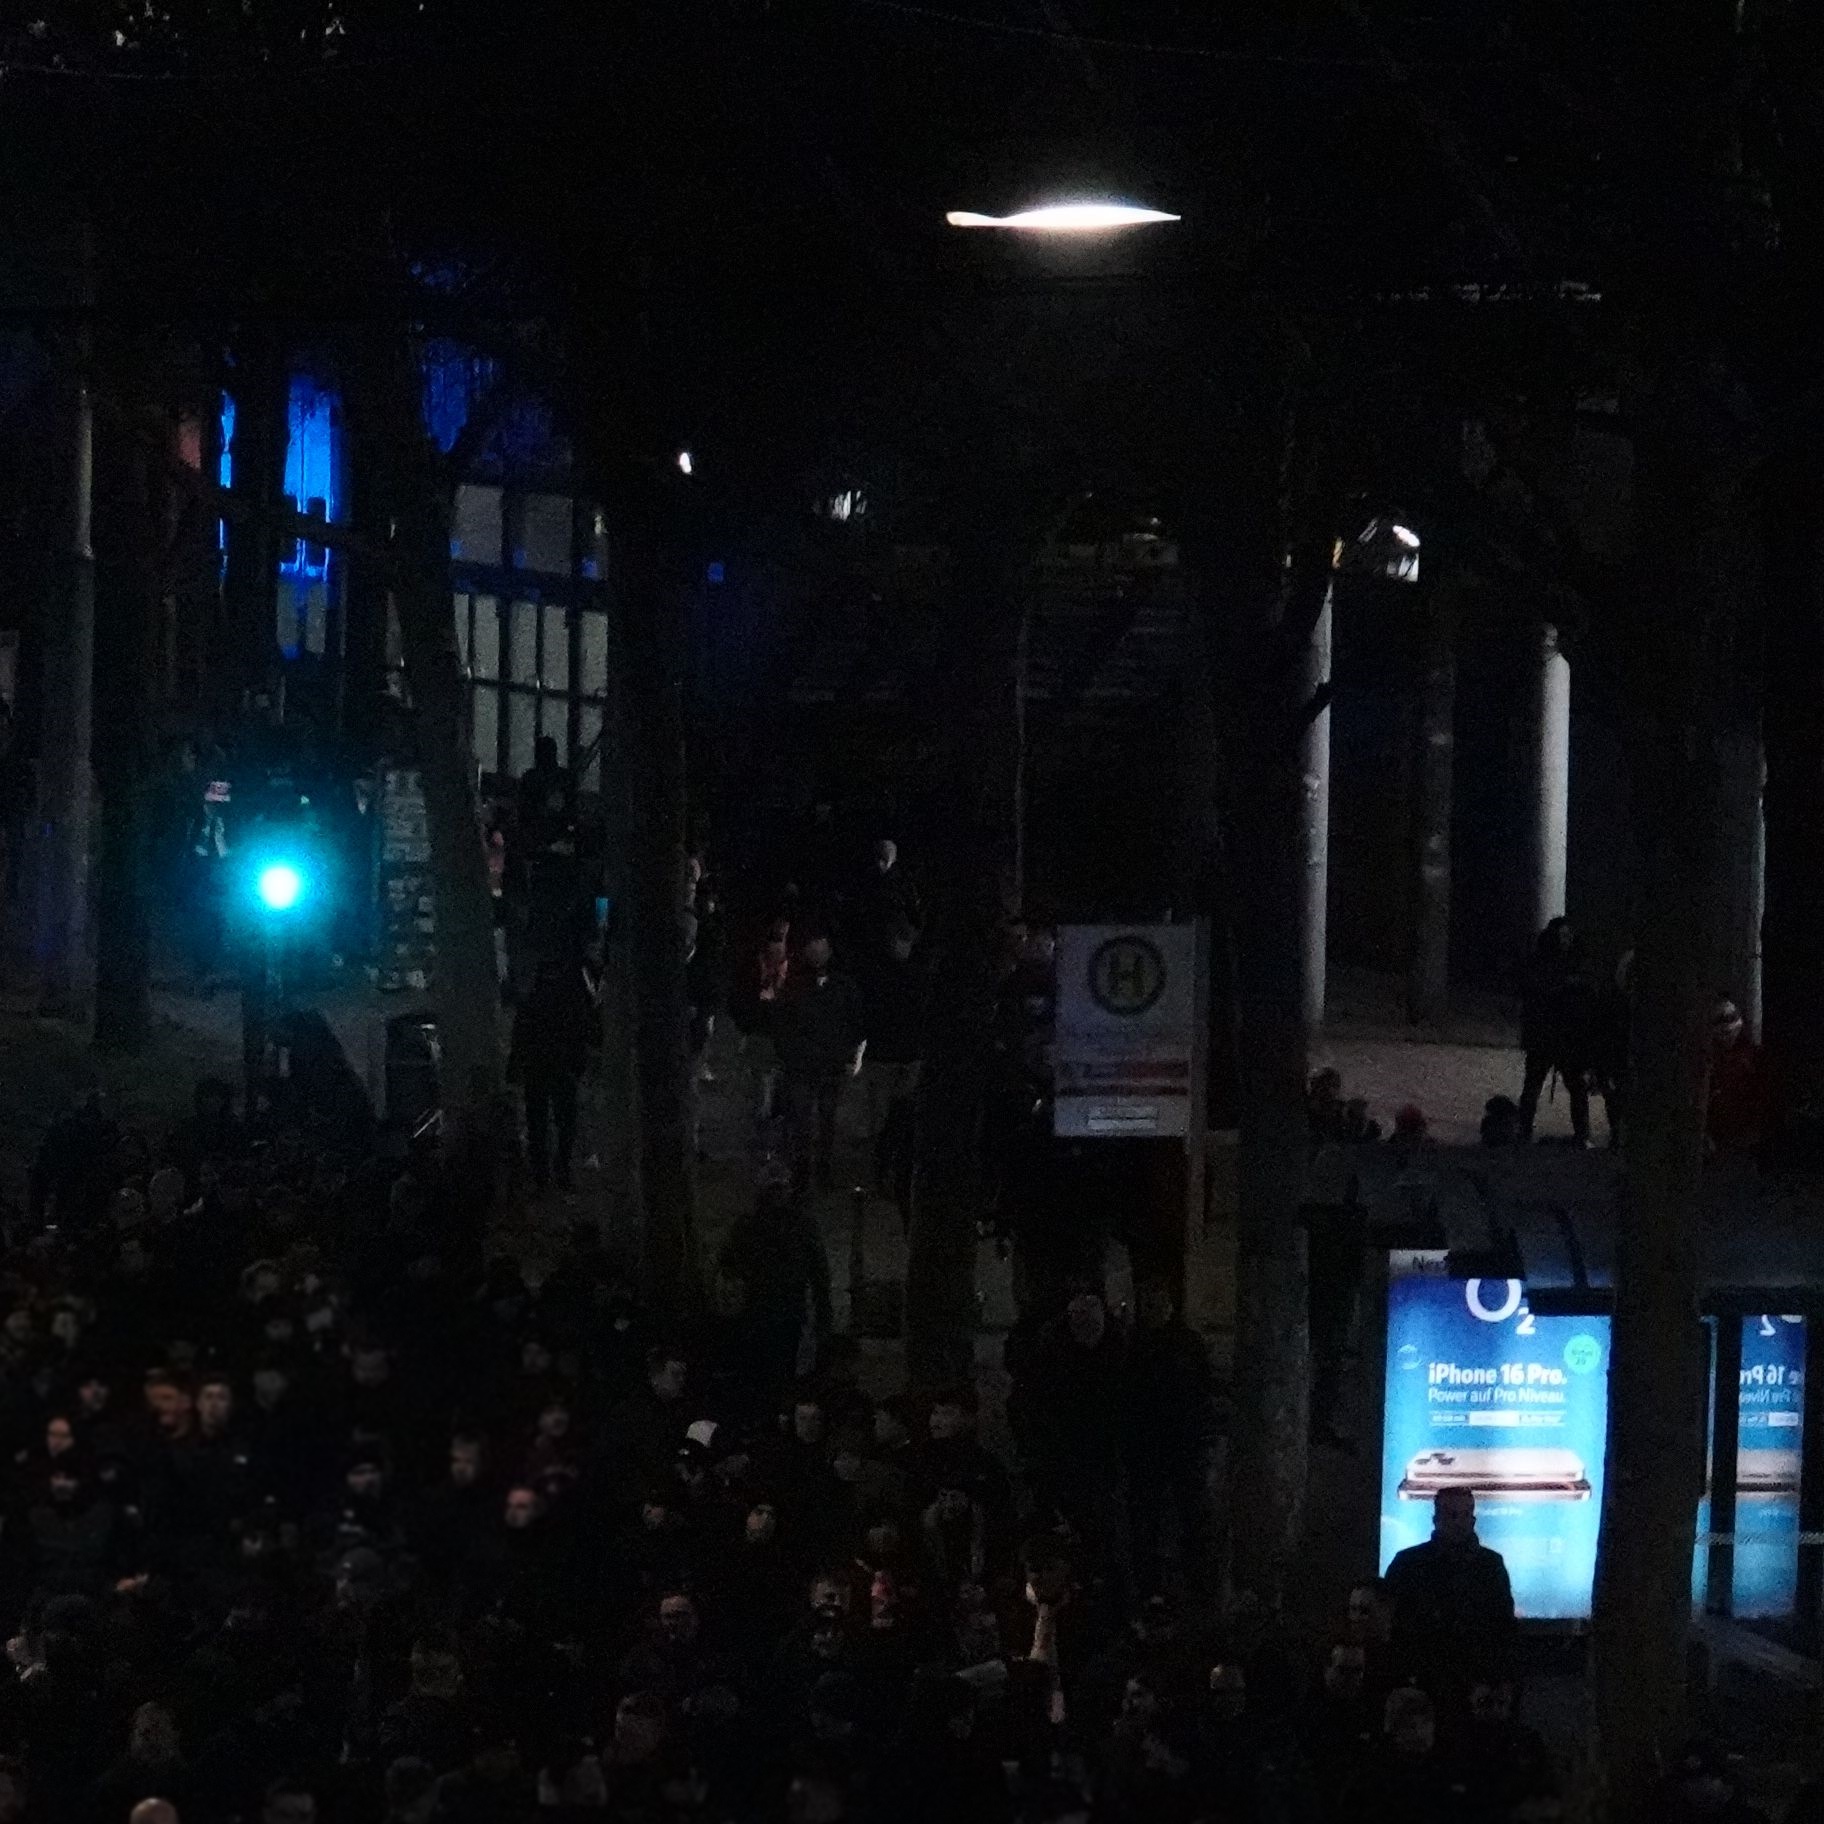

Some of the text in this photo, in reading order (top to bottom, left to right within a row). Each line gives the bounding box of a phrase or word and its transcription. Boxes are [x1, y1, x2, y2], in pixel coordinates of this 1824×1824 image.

[1109, 953, 1145, 999] H
[1428, 1362, 1567, 1385] iPhone 16 Pro.
[1428, 1387, 1467, 1403] Power
[1470, 1387, 1494, 1402] auf
[1494, 1387, 1516, 1402] Pro
